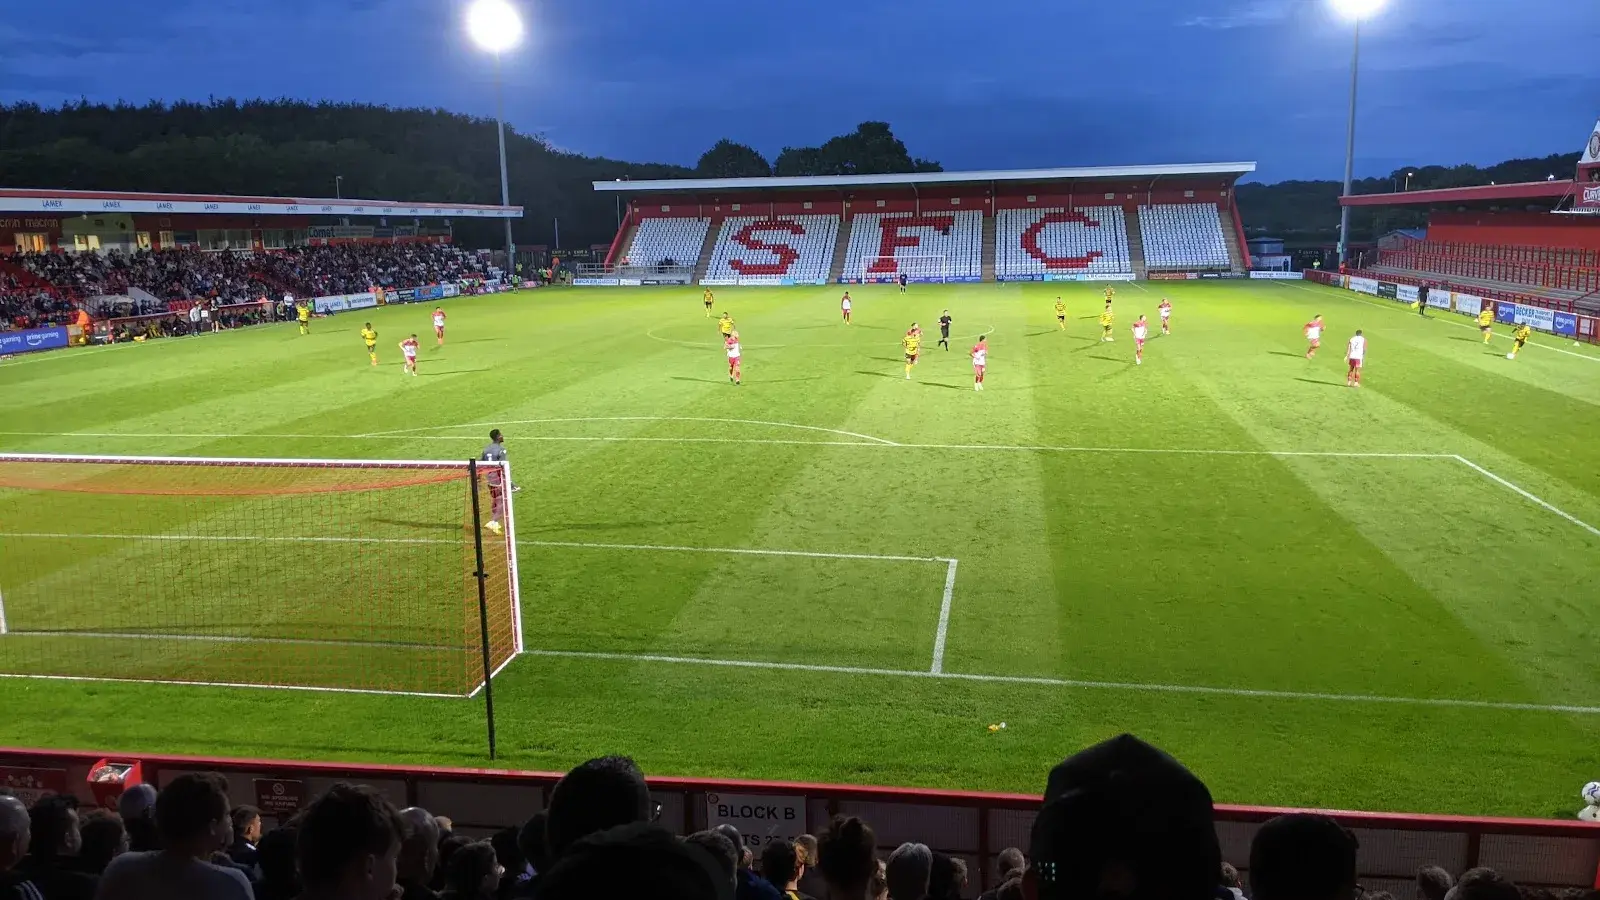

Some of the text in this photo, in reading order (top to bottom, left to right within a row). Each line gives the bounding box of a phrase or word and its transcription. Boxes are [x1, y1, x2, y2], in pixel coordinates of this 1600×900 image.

[42, 200, 63, 208] LAMEX
[308, 226, 335, 237] Comet
[27, 331, 59, 343] prime gaming
[718, 804, 796, 820] BLOCK B
